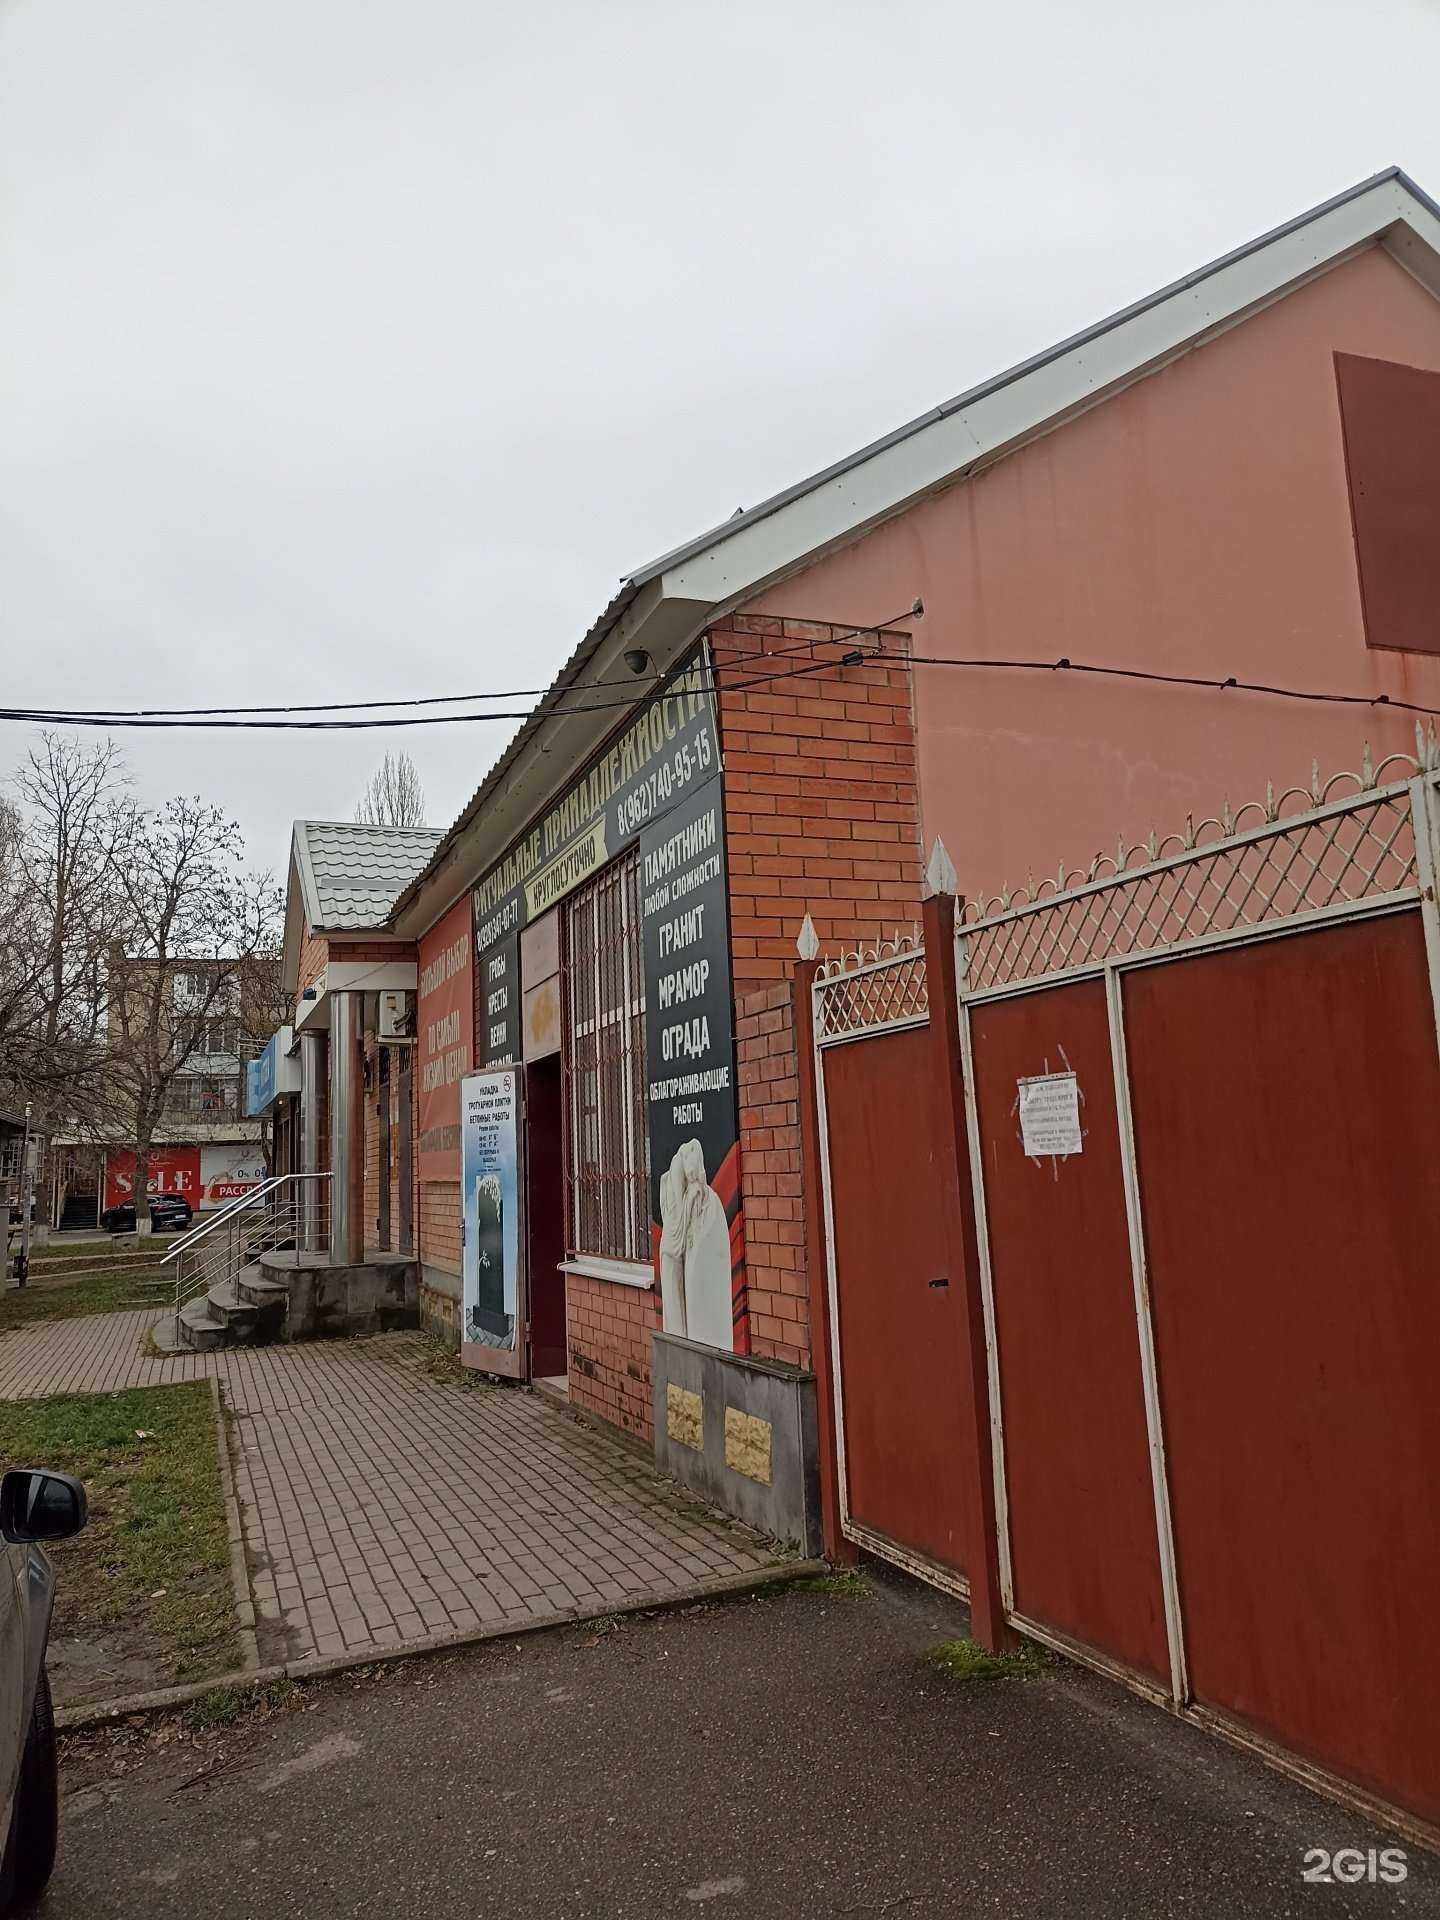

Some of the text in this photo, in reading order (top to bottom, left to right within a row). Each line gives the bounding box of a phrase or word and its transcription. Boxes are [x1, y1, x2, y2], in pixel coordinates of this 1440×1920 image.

[474, 655, 706, 920] РИТУАЛЬНЫЕ ПРИНАДЛЕЖНОСТИ
[617, 727, 711, 836] 8(962)740-95-15
[533, 835, 596, 909] КРУГЛОСУТОЧНО
[644, 808, 716, 887] ПАМЯТНИКИ
[658, 904, 705, 958] ГРАНИТ
[488, 952, 506, 982] ГРОБЫ
[658, 959, 709, 1010] МРАМОР
[487, 985, 508, 1016] КРЕСТЫ
[662, 1016, 711, 1060] ОГРАДА
[649, 1066, 730, 1101] ОБЛАГОРАЖИВАЮЩИЕ
[672, 1102, 703, 1125] РАБОТЫ
